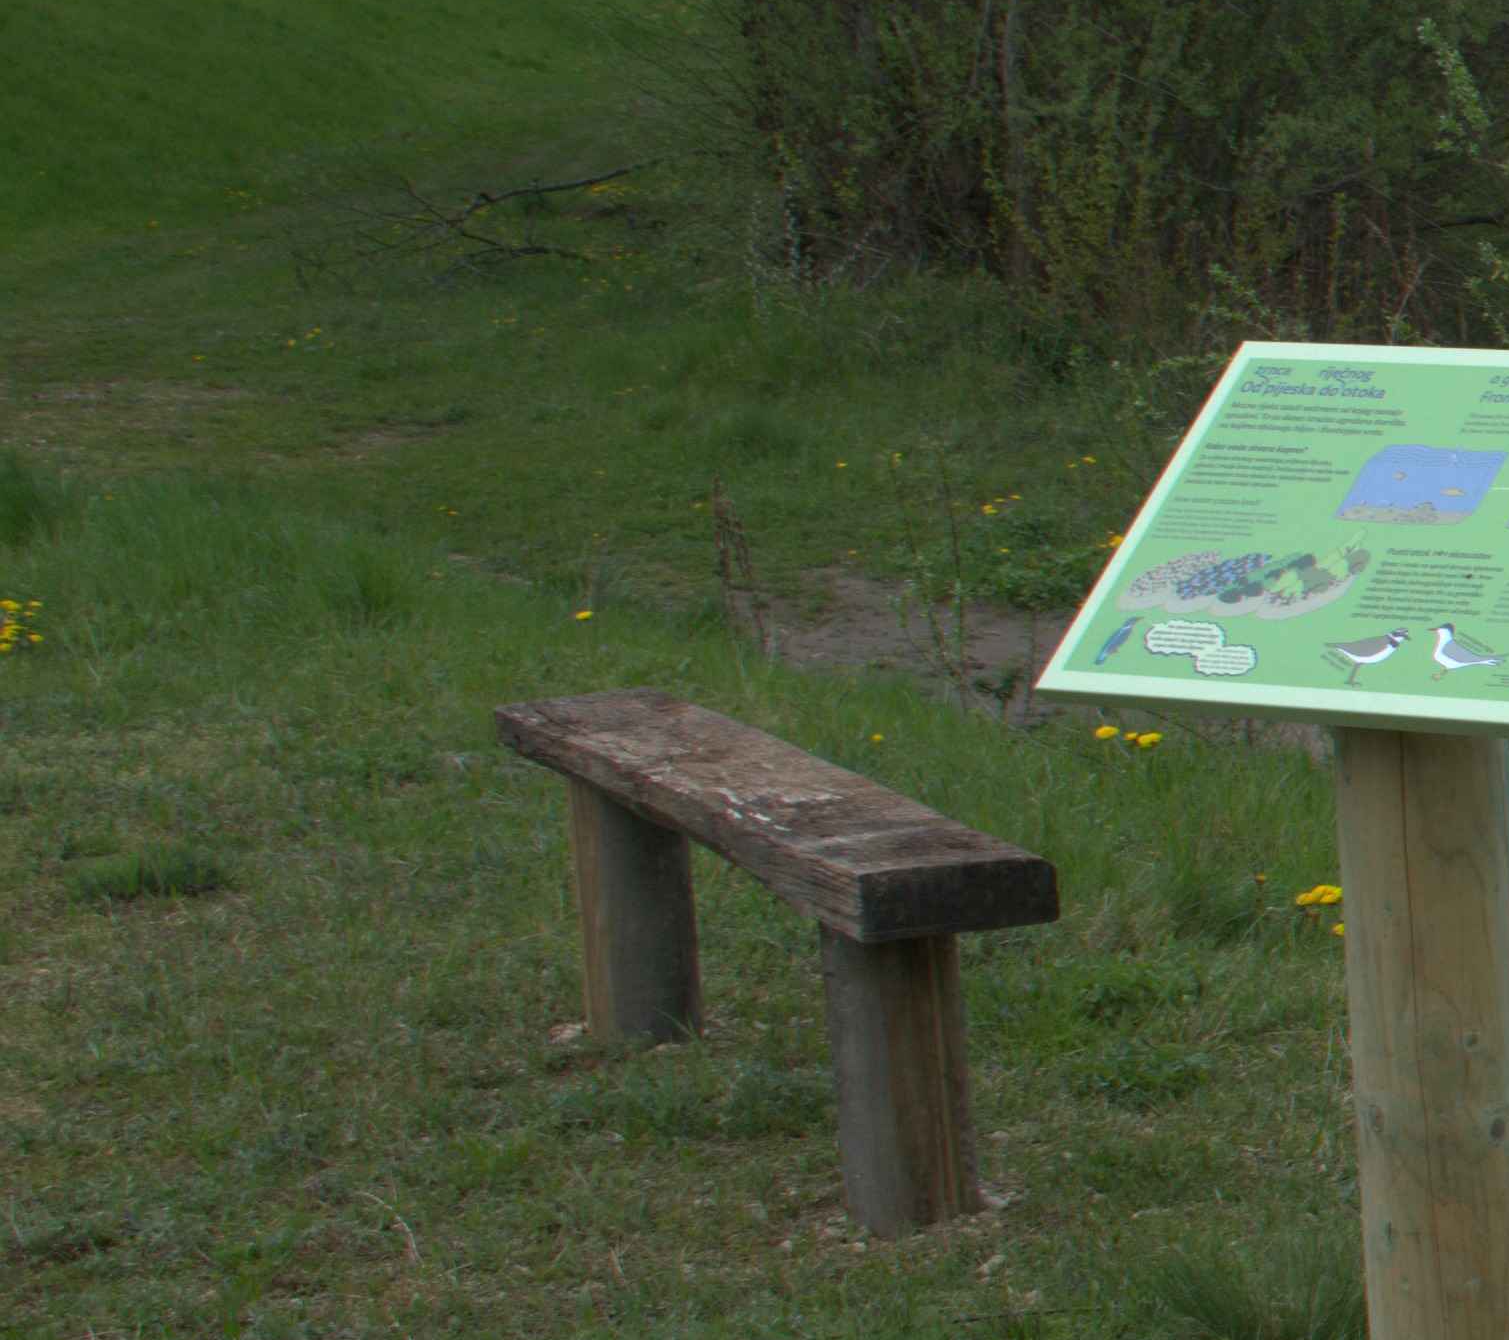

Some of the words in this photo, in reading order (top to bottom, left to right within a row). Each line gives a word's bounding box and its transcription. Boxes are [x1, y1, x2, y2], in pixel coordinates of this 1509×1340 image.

[1240, 381, 1260, 394] Od
[1262, 383, 1315, 397] pijeska
[1318, 384, 1338, 397] do
[1341, 387, 1385, 399] otoka
